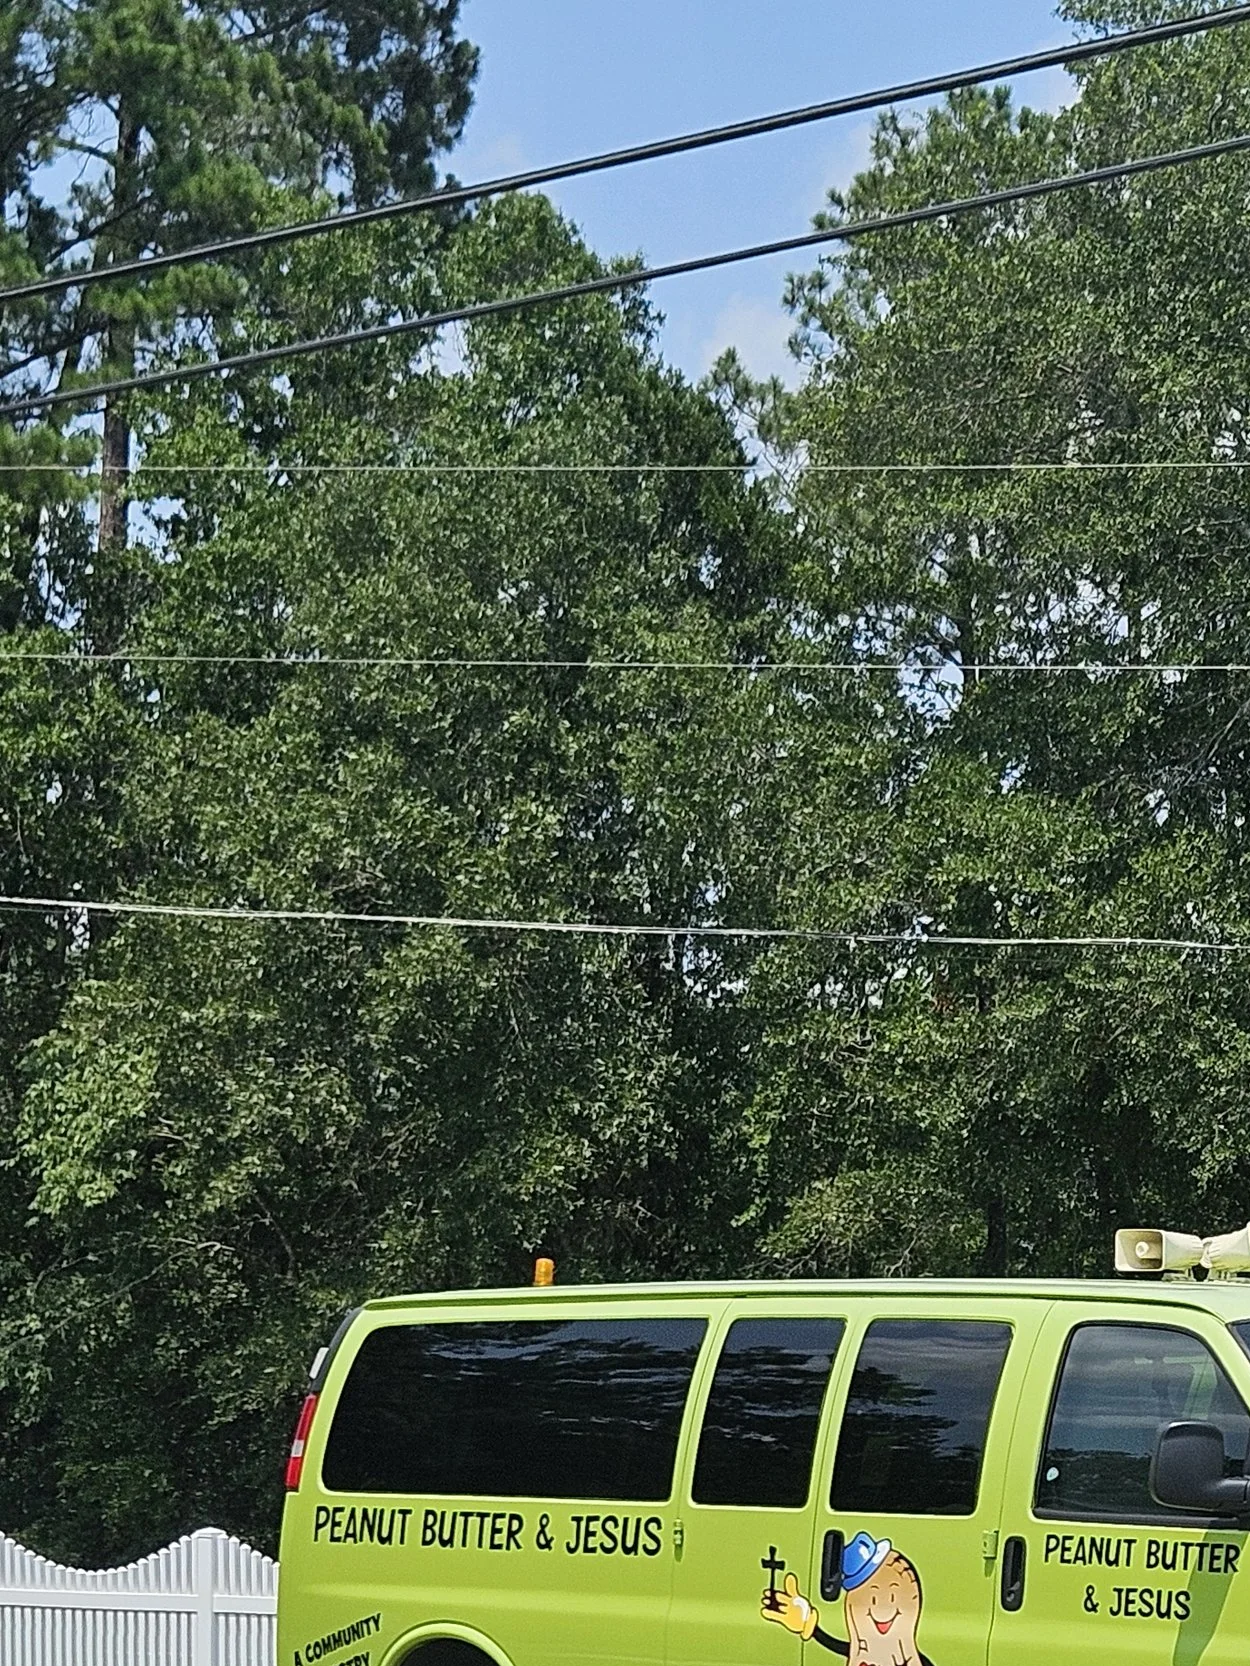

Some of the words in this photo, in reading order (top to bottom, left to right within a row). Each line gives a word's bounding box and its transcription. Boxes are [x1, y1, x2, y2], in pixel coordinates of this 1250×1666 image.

[313, 1505, 412, 1545] PEANUT
[421, 1510, 524, 1550] BUTTER
[535, 1513, 554, 1551] &
[565, 1514, 662, 1557] JESUS
[1044, 1533, 1137, 1566] PEANUT
[1146, 1538, 1241, 1574] BUTTER
[1083, 1584, 1099, 1614] &
[1109, 1587, 1191, 1622] JESUS
[305, 1612, 381, 1663] COMMUNITY
